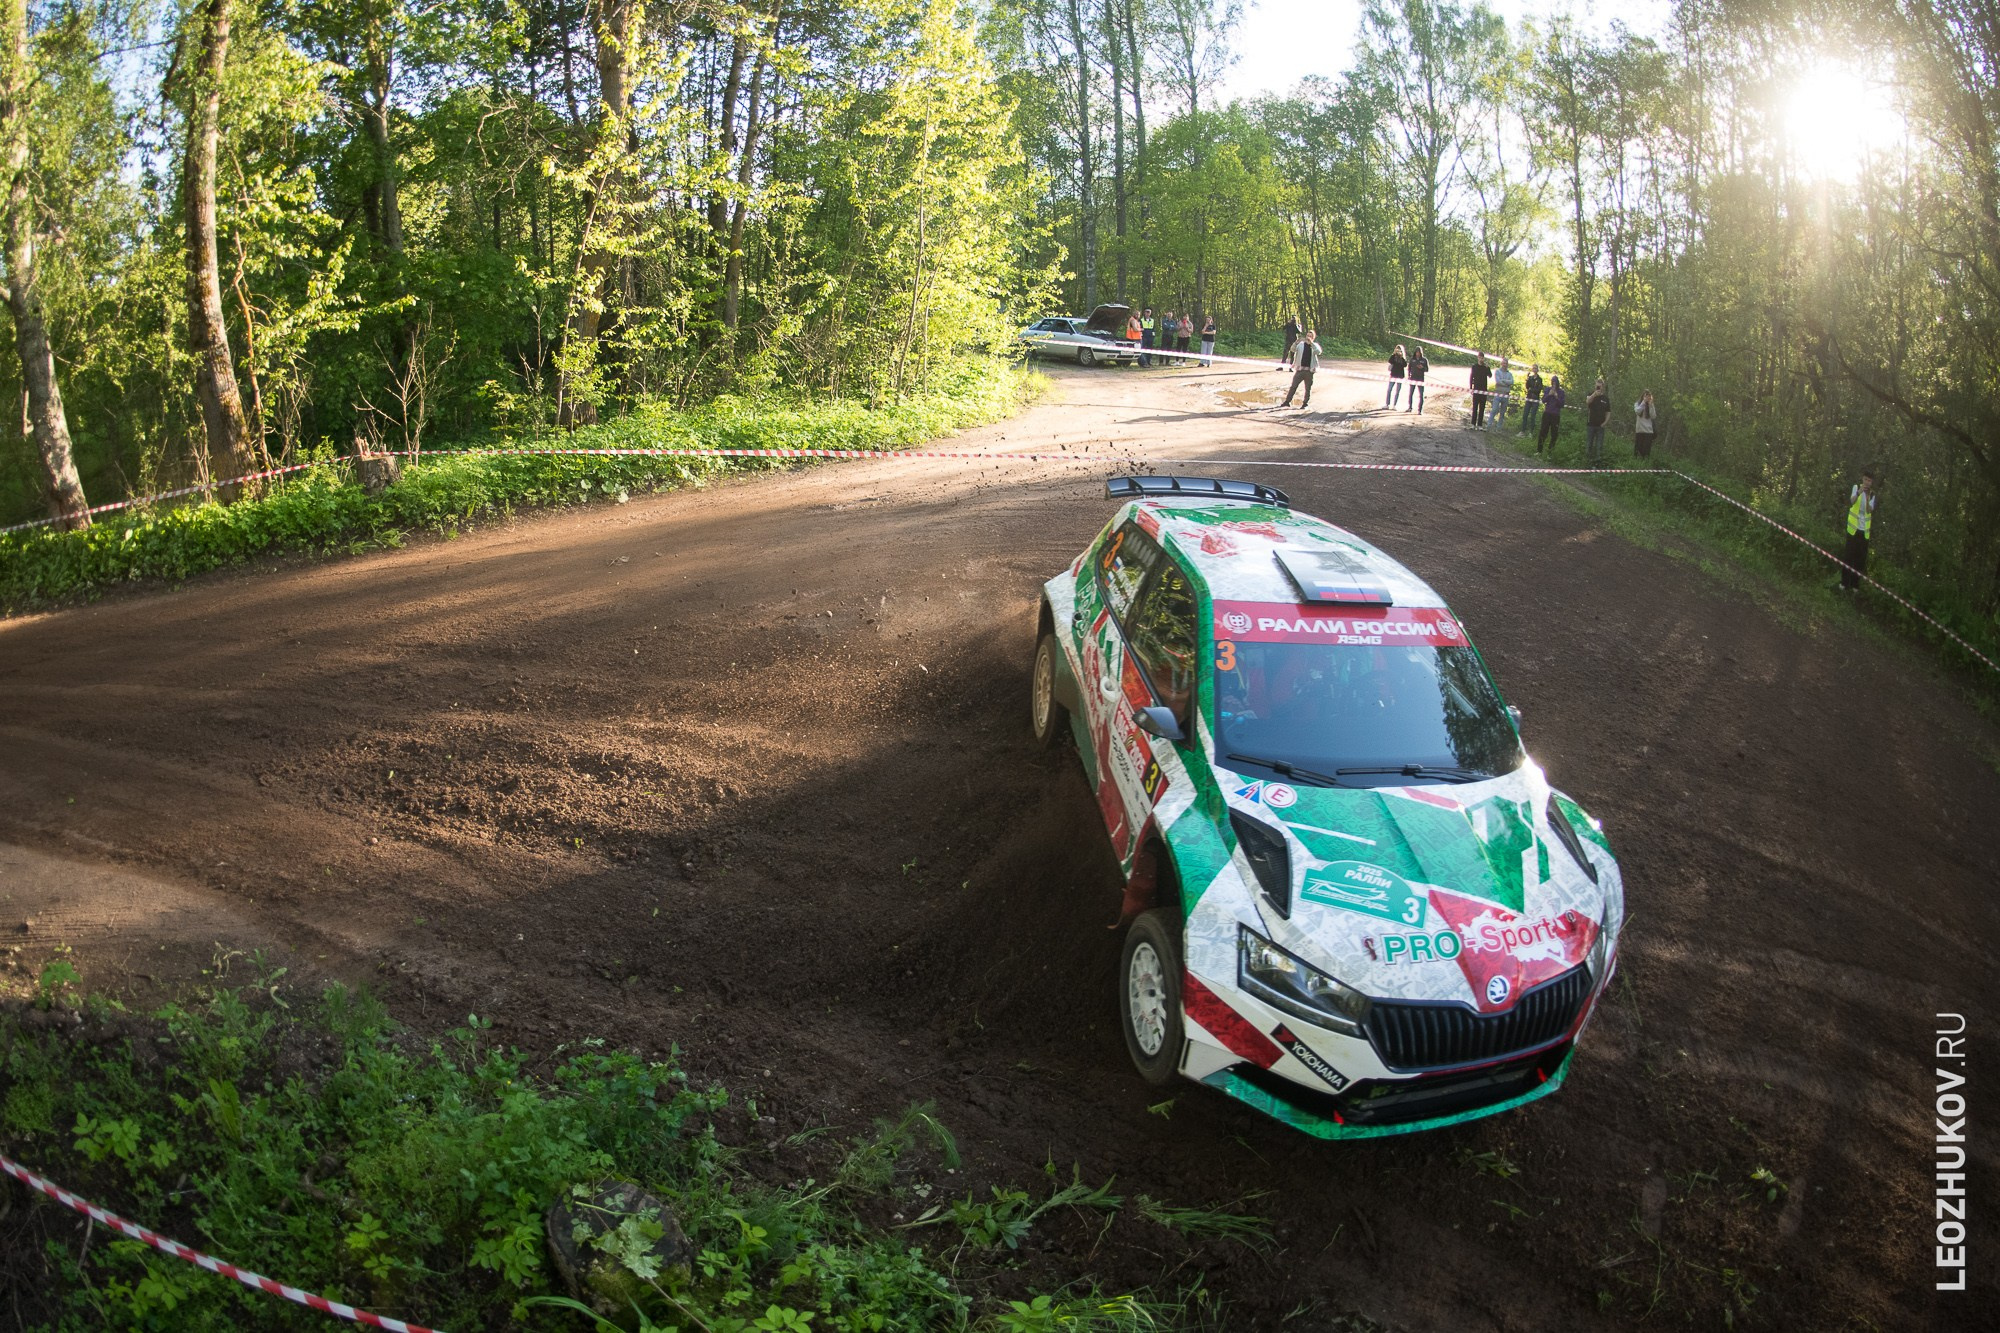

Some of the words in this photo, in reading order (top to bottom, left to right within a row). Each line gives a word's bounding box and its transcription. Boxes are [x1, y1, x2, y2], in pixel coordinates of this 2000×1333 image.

[1103, 532, 1125, 569] 3
[1257, 617, 1347, 635] РАЛЛИ
[1351, 620, 1437, 637] РОССИИ
[1215, 640, 1236, 671] 3
[1145, 762, 1158, 794] 3
[1270, 787, 1289, 802] E
[1344, 869, 1393, 889] РАЛЛИ
[1357, 864, 1383, 877] 2025
[1401, 897, 1421, 924] 3
[1291, 1041, 1344, 1088] YOKOHAMA
